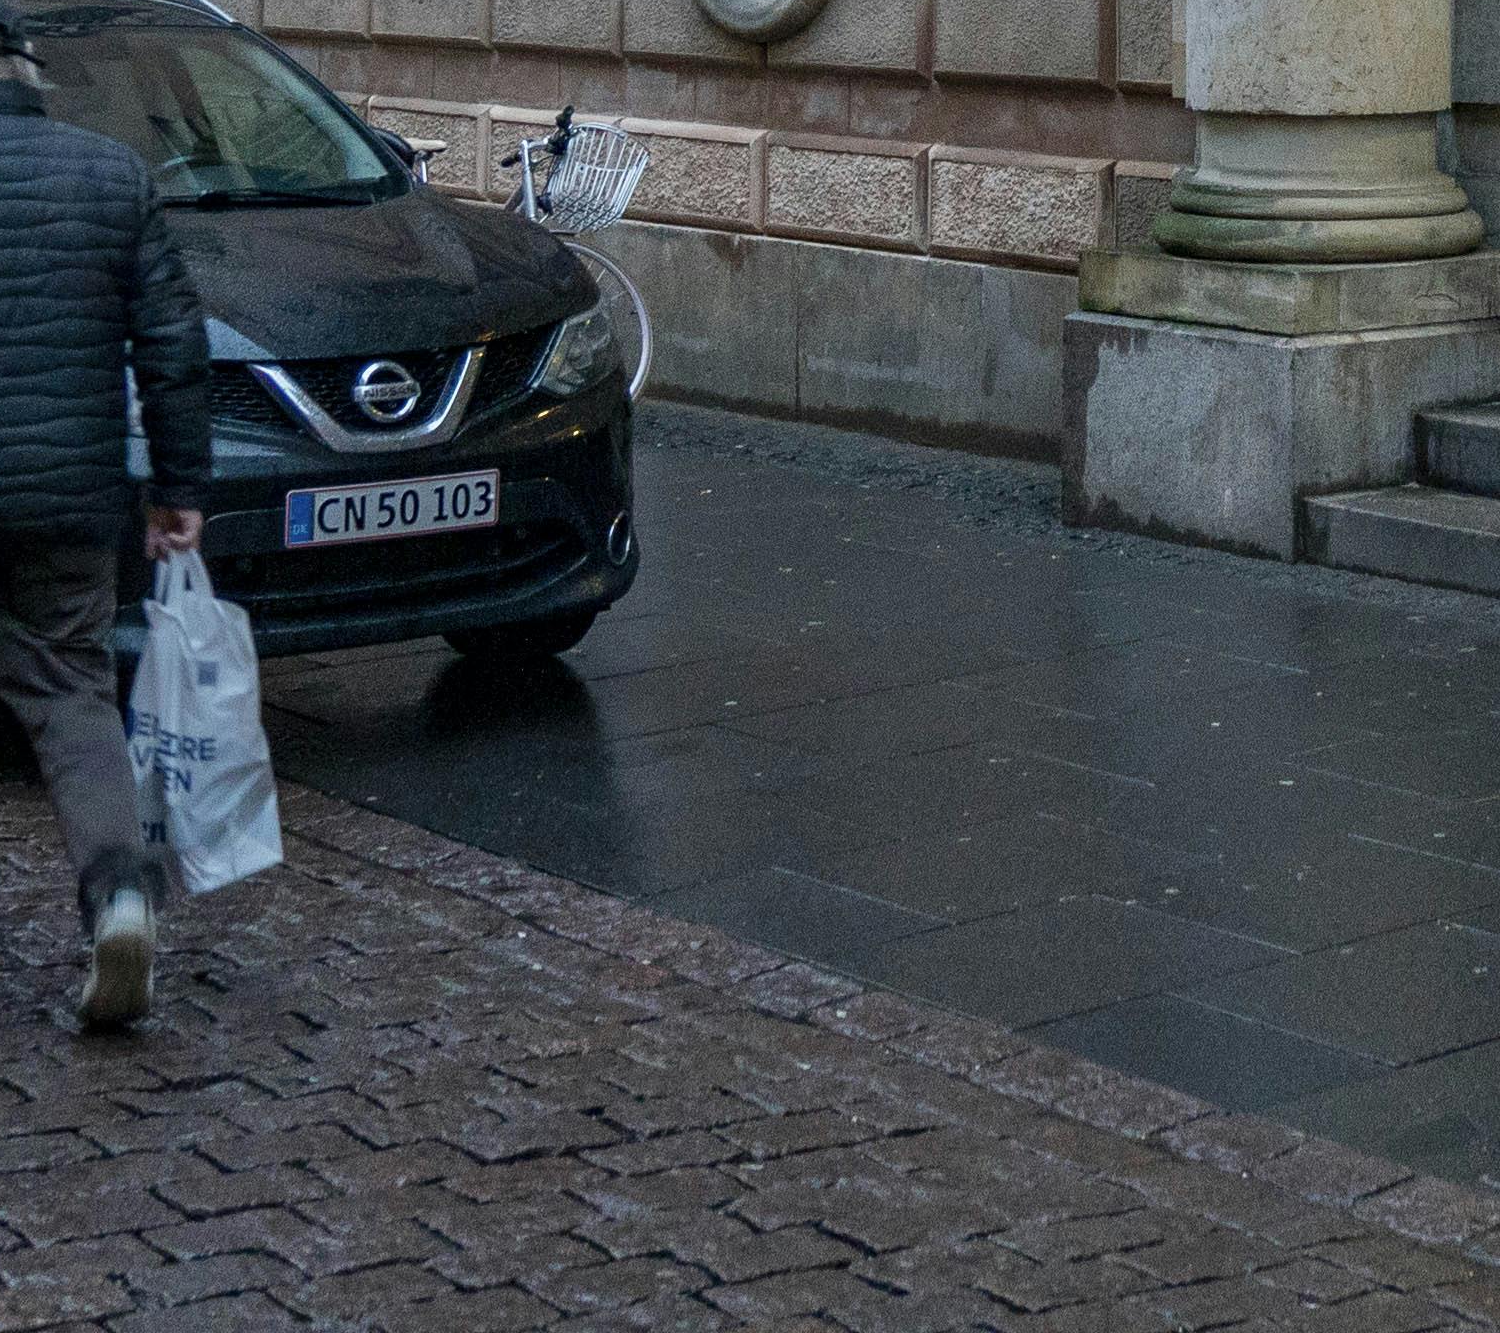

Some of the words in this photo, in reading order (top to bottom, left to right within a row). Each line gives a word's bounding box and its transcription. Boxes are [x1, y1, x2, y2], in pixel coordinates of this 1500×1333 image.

[317, 495, 366, 534] CN
[377, 489, 420, 528] 50
[432, 481, 493, 522] 103
